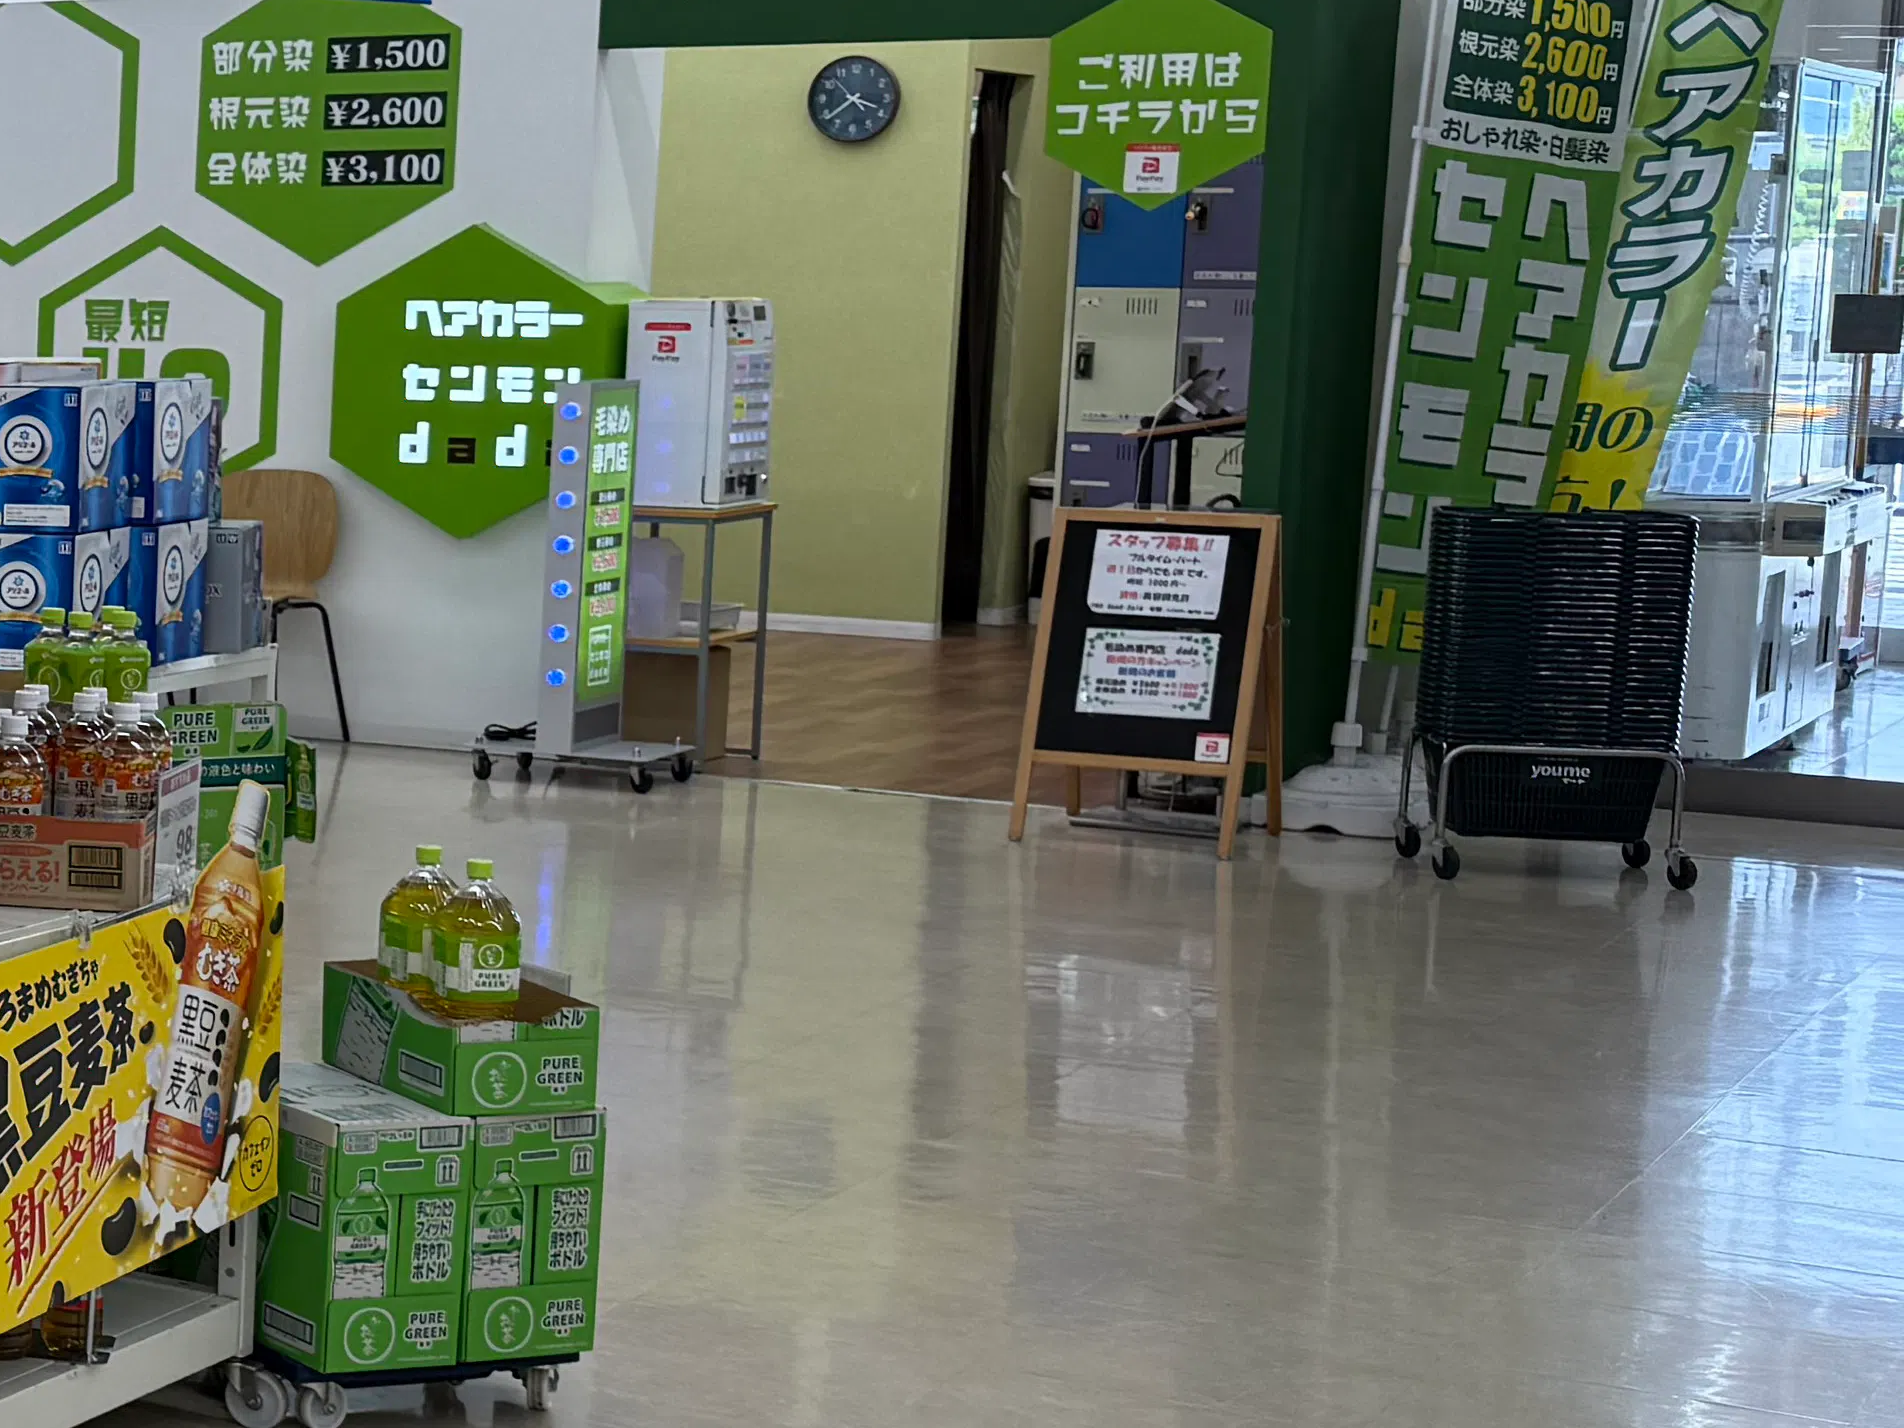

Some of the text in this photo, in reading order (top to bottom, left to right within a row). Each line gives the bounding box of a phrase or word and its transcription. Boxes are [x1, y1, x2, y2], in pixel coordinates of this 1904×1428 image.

[212, 38, 447, 76] 部分染 ¥1,500
[1078, 52, 1242, 91] ご利用は
[1458, 29, 1618, 83] 根元染 2,600円
[209, 95, 444, 131] 根元染 ¥2,600
[1055, 99, 1260, 136] コチラから
[1450, 74, 1612, 125] 全体染 3,100円
[1439, 117, 1611, 164] おしゃれ染・白髪染
[207, 151, 441, 186] 全体染 ¥3,100
[84, 299, 170, 342] 最短
[405, 300, 584, 339] ヘアカラー
[594, 405, 631, 436] 毛染め
[398, 422, 554, 467] dad
[173, 712, 214, 727] PURE
[1531, 764, 1591, 782] youme
[195, 940, 241, 993] むぎ茶
[182, 991, 215, 1050] 黒豆
[536, 1070, 584, 1086] GREEN
[542, 1056, 580, 1070] PURE
[166, 1057, 204, 1113] 麦茶
[5, 1099, 118, 1294] 新登場
[410, 1260, 451, 1282] ボトル
[548, 1249, 588, 1270] ボトル
[409, 1312, 446, 1327] PURE
[541, 1313, 586, 1328] GREEN
[546, 1299, 581, 1314] PURE
[404, 1326, 448, 1341] GREEN
